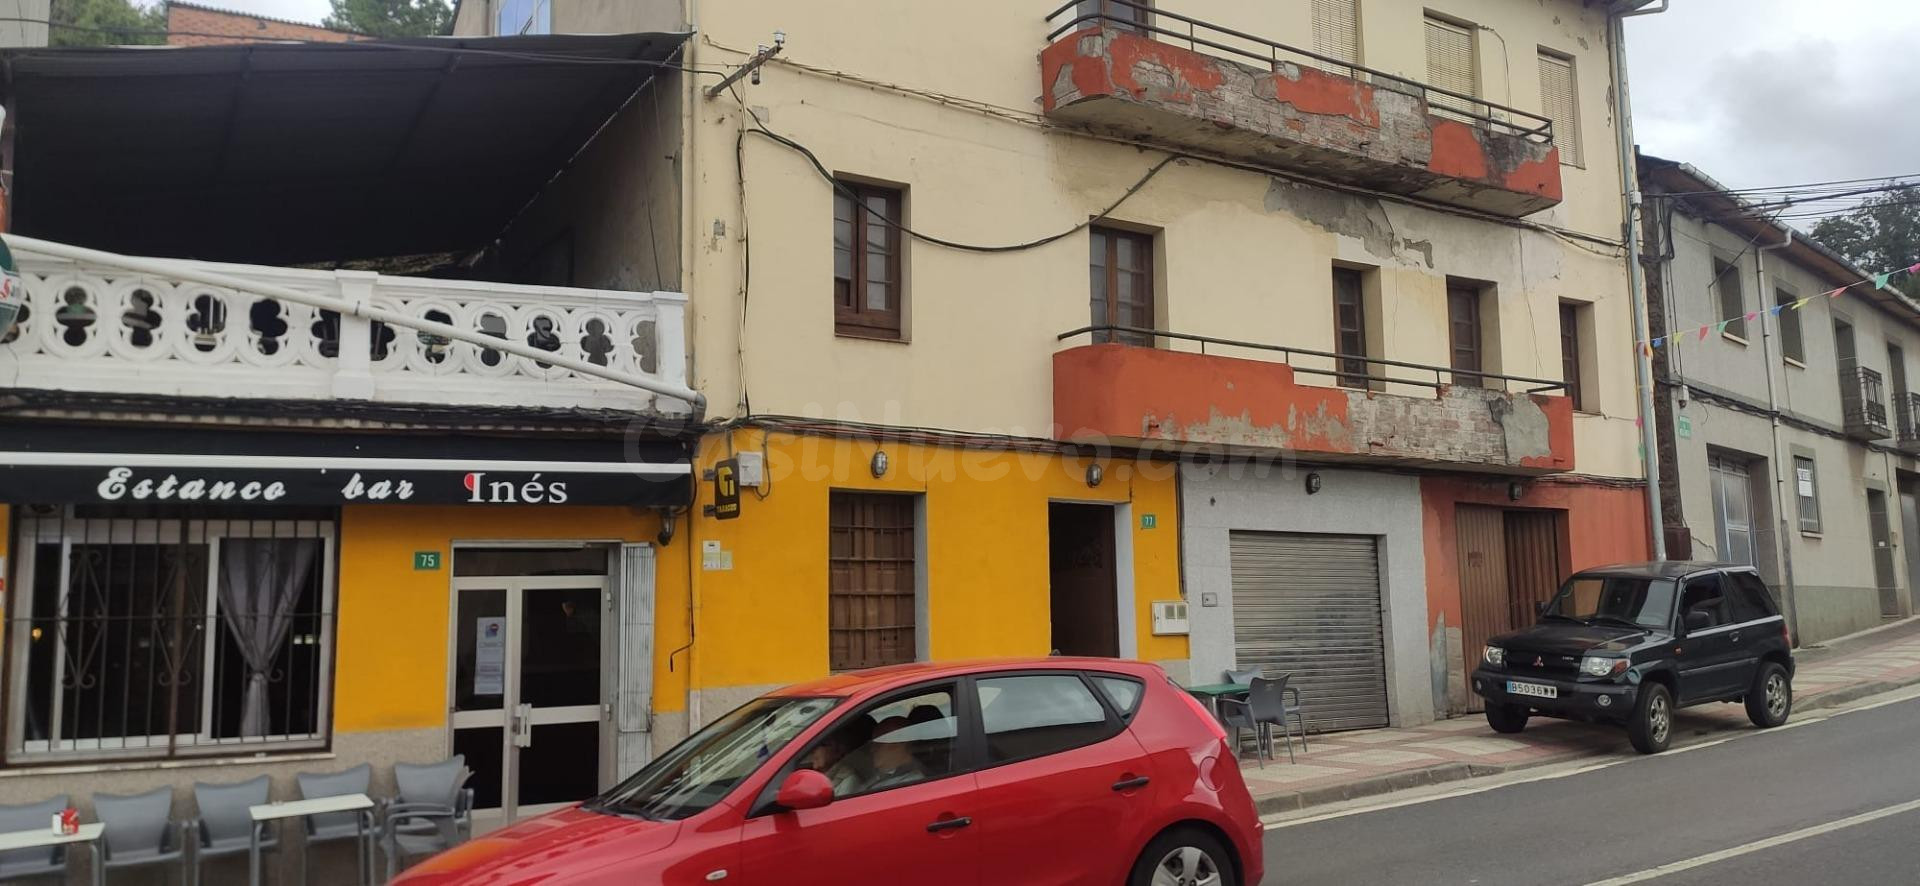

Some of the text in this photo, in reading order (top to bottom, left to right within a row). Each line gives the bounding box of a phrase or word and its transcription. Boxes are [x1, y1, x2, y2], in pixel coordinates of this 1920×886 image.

[97, 466, 568, 503] Estanco bar Inés
[420, 554, 435, 567] 75
